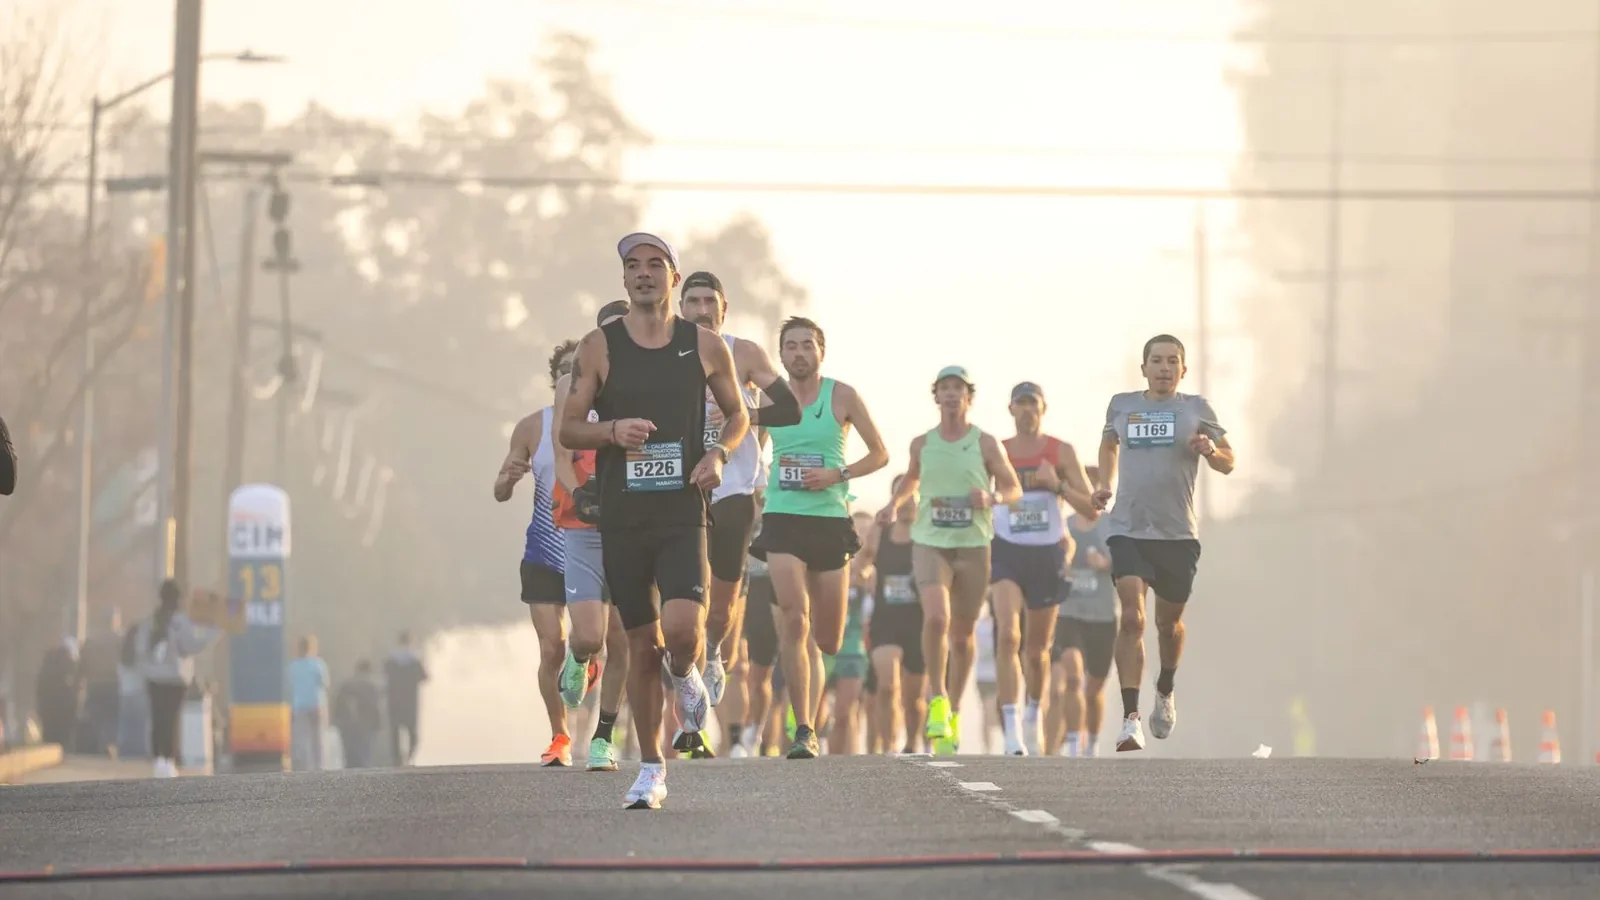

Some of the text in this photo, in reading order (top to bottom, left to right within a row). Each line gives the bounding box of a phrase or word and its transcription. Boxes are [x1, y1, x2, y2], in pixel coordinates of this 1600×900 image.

[1134, 424, 1167, 436] 1169
[634, 461, 675, 477] 5226
[239, 564, 280, 599] 13
